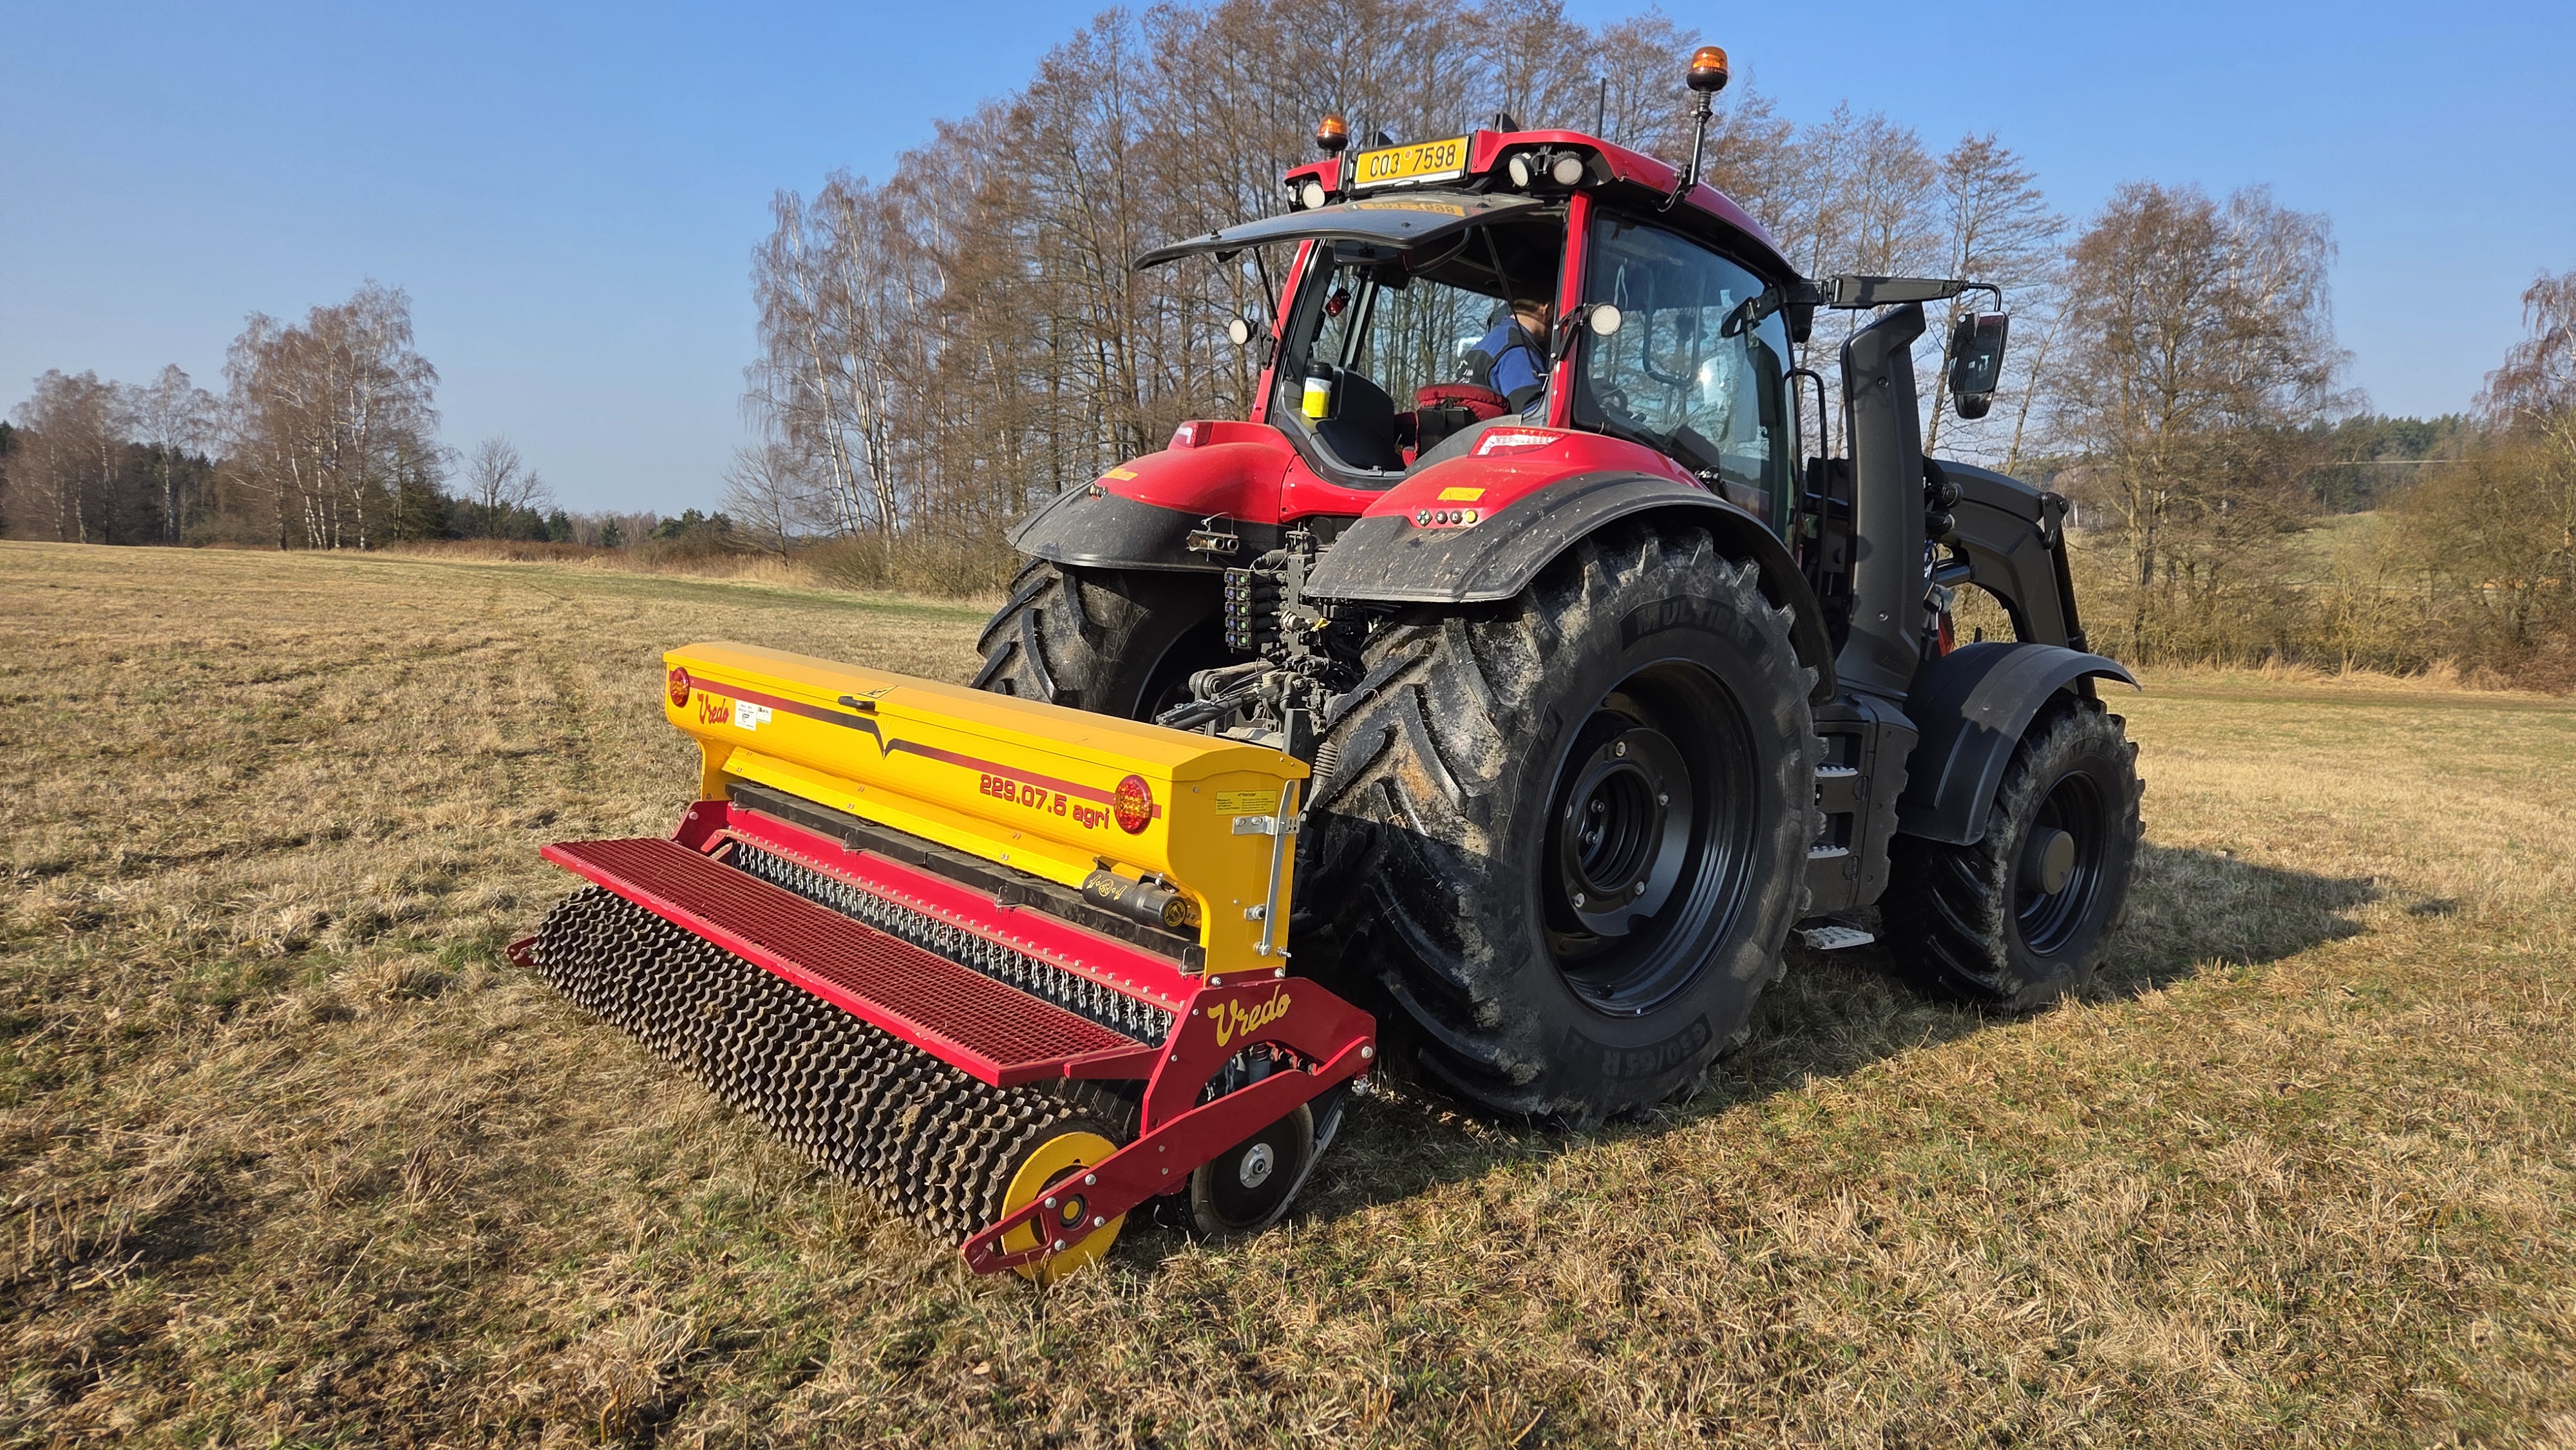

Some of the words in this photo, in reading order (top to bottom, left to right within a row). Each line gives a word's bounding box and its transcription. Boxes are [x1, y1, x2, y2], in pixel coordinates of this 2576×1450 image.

[1412, 144, 1456, 172] 7598
[697, 692, 730, 724] Vredo
[980, 773, 1067, 816] 229.07.5
[1072, 804, 1110, 829] agri
[1208, 984, 1291, 1047] Vredo
